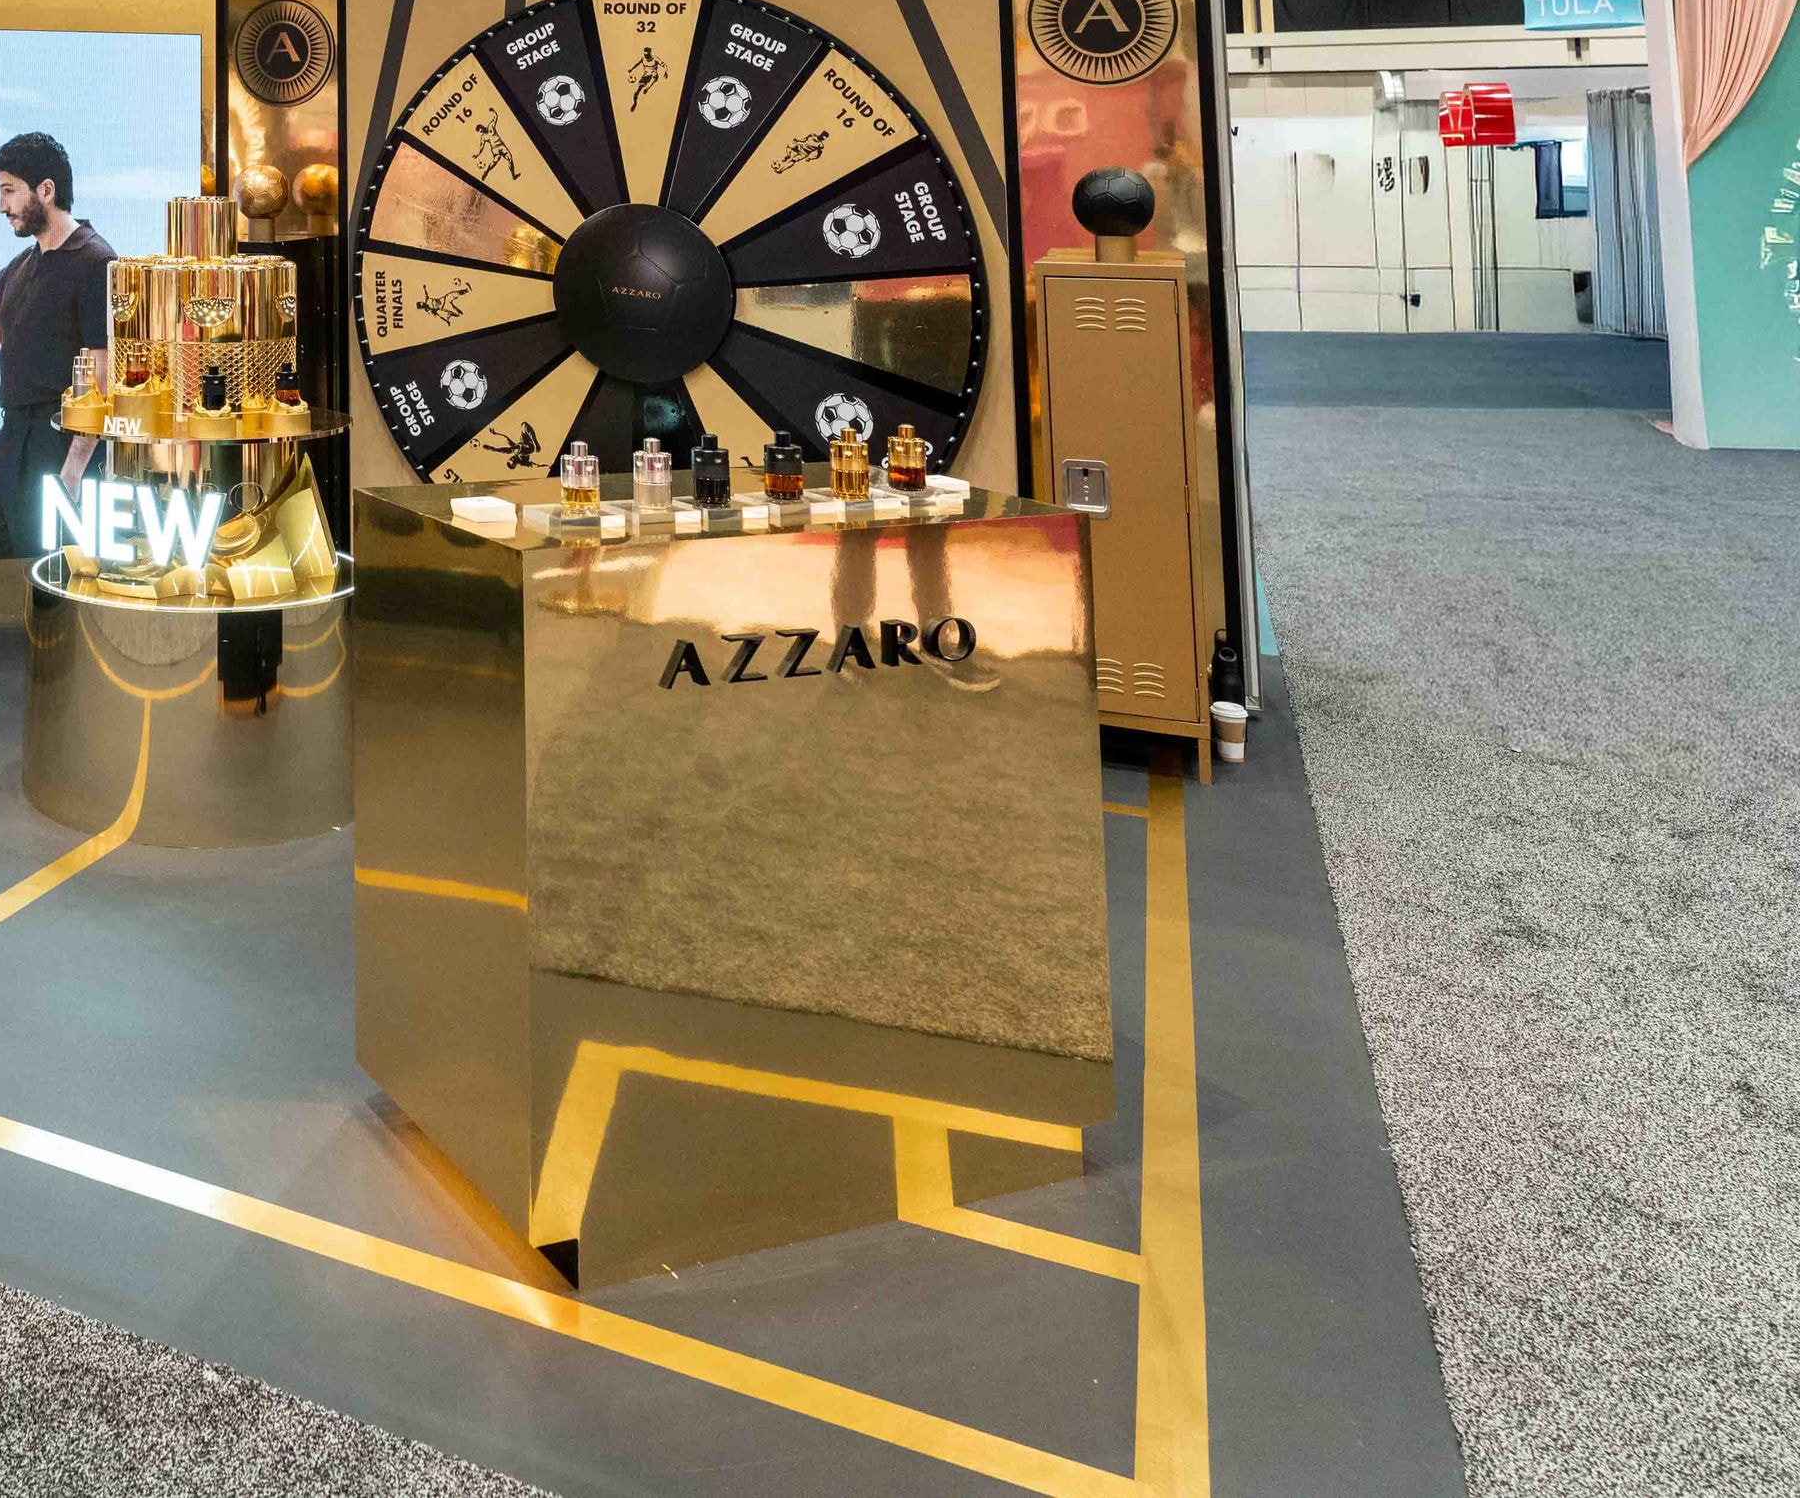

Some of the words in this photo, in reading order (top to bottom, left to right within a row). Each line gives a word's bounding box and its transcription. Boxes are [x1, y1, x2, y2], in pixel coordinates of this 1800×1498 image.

[603, 2, 662, 15] ROUND
[665, 2, 687, 15] OF
[505, 22, 556, 56] GROUP
[635, 20, 656, 33] 32
[729, 22, 788, 56] GROUP
[264, 30, 301, 65] A
[516, 39, 561, 71] STAGE
[724, 41, 775, 73] STAGE
[421, 91, 464, 137] ROUND
[462, 72, 480, 93] OF
[455, 106, 473, 125] 16
[822, 68, 875, 119] ROUND
[872, 117, 897, 139] OF
[835, 108, 857, 129] 16
[894, 191, 925, 244] STAGE
[913, 181, 947, 242] GROUP
[375, 269, 388, 338] QUARTER
[391, 278, 404, 330] FINALS
[611, 286, 662, 300] AZZARO
[389, 386, 422, 437] GROUP
[405, 380, 435, 427] STAGE
[103, 415, 143, 436] NEW
[40, 473, 228, 570] NEW
[657, 615, 977, 690] AZZARO
